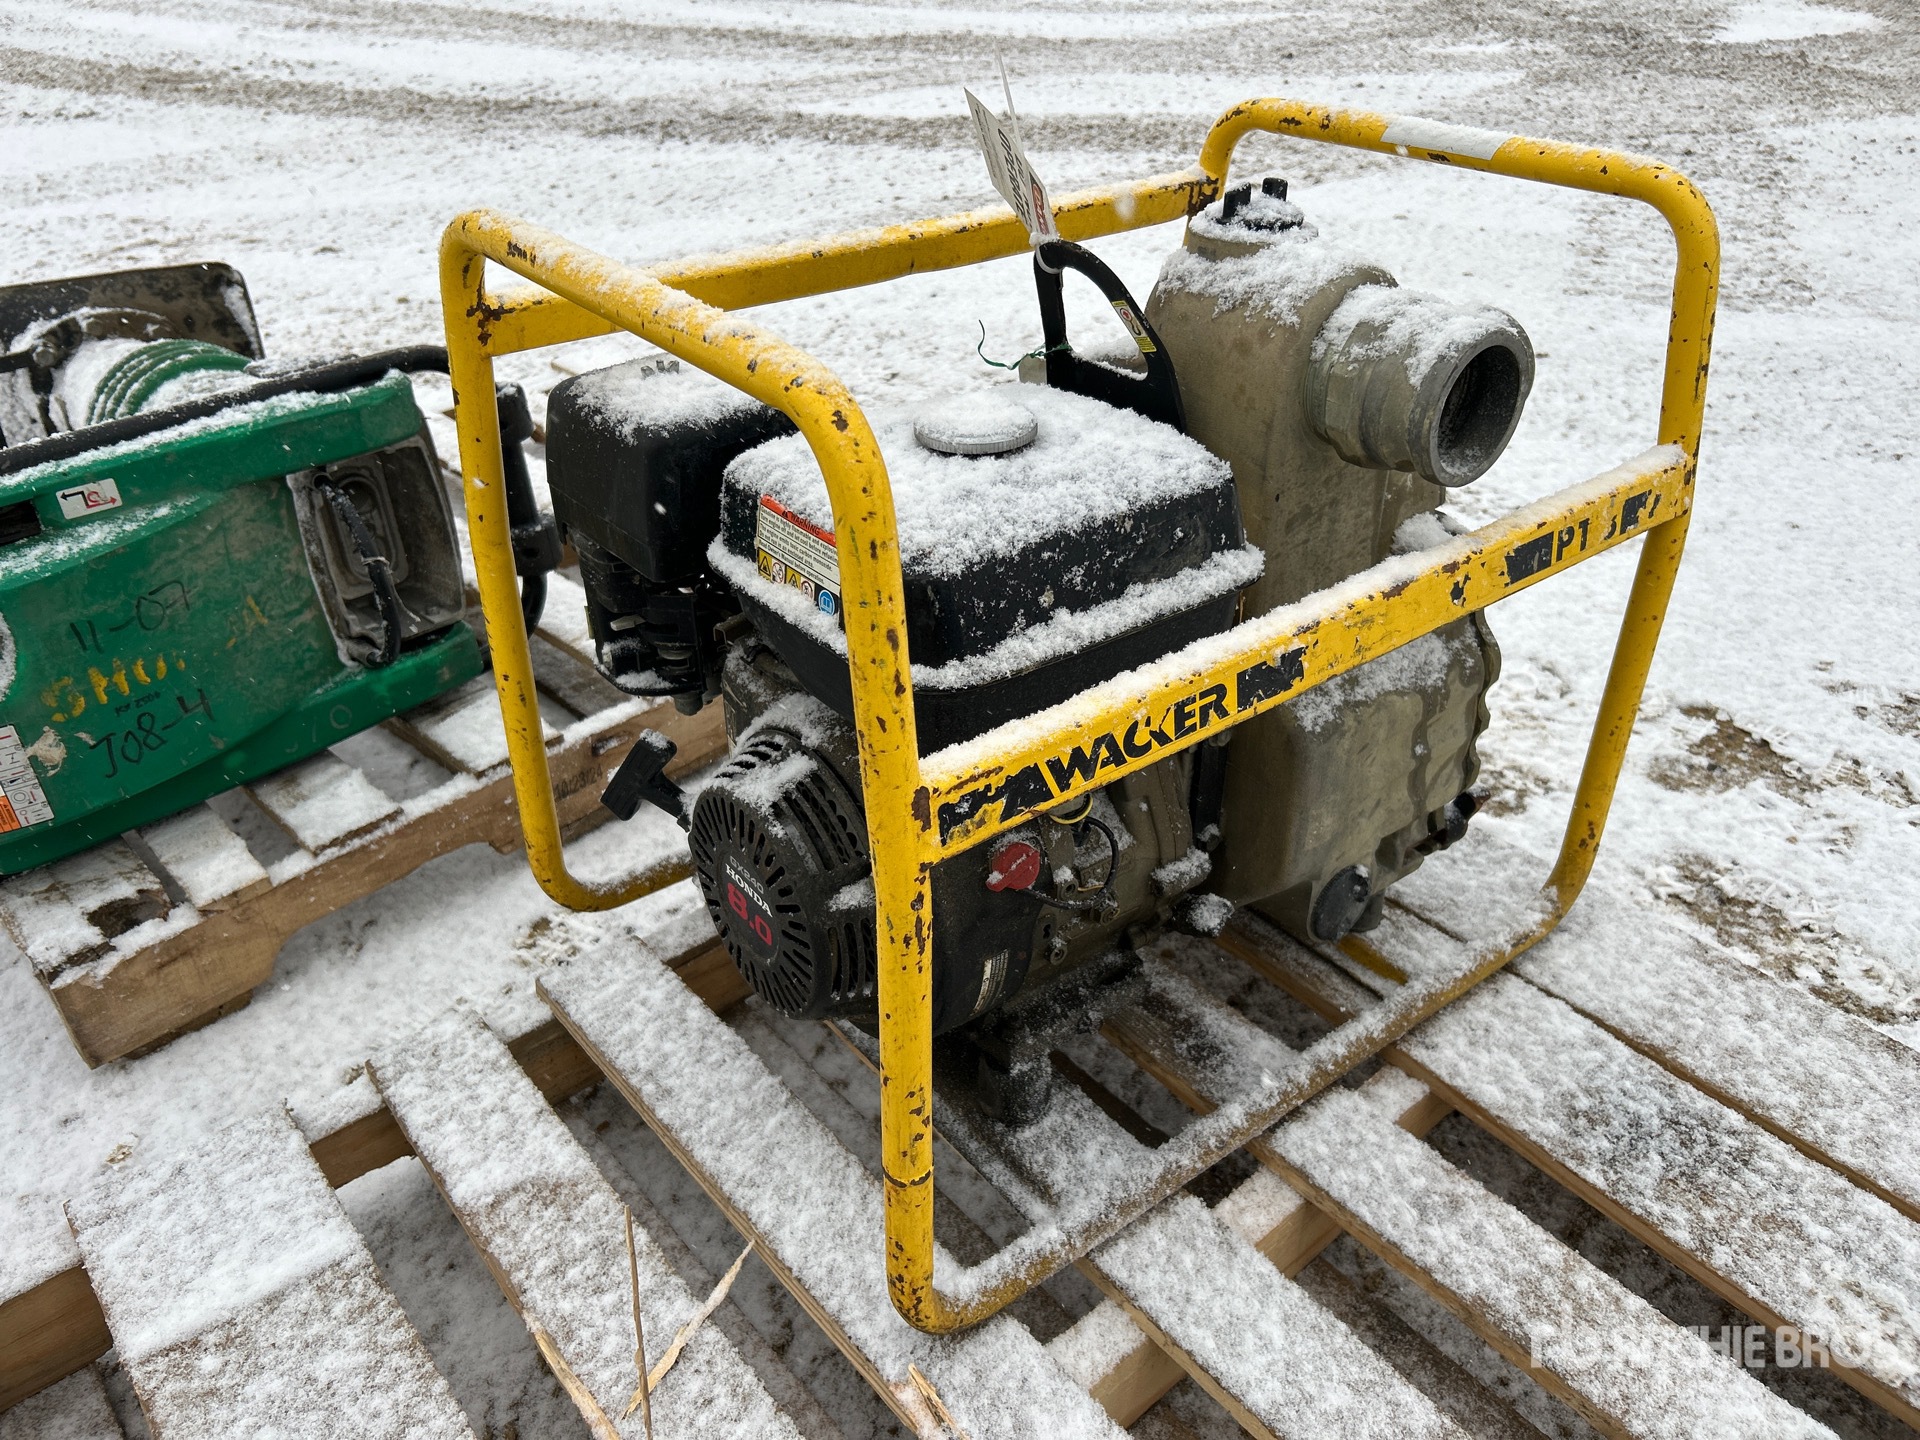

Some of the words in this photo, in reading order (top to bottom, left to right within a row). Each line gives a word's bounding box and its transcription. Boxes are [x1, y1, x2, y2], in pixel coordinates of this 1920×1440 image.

[791, 512, 820, 536] WARNING
[1044, 683, 1231, 794] WACKER
[725, 863, 774, 918] HONDA
[729, 855, 765, 895] GX240
